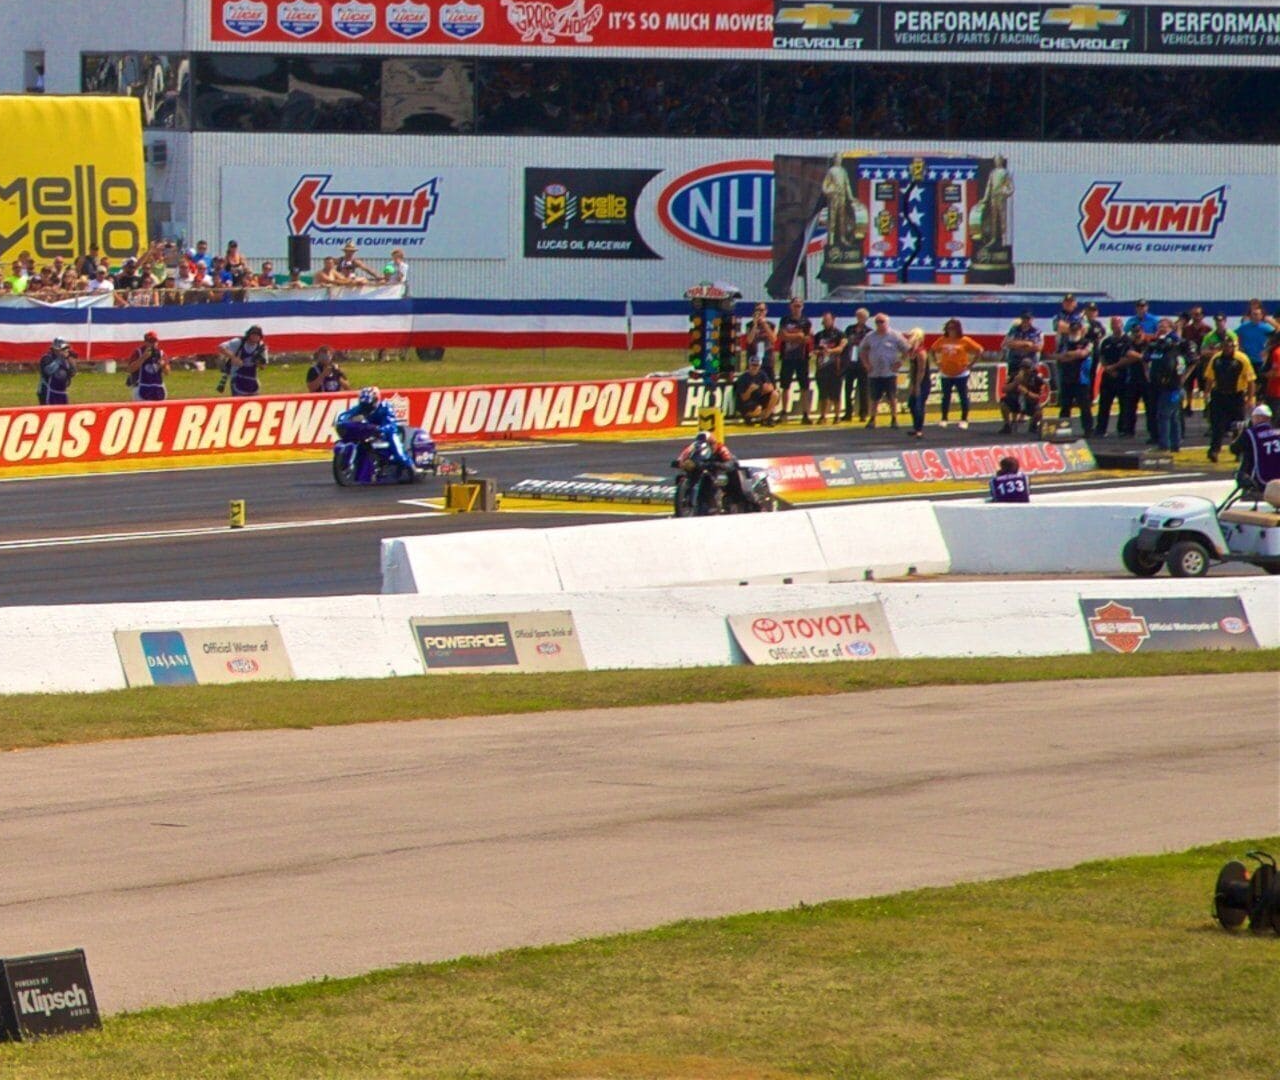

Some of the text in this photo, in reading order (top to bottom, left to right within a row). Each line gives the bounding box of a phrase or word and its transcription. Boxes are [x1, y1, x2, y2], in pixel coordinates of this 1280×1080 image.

[609, 12, 774, 32] IT'S SO MUCH MOWER
[894, 11, 1040, 32] PERFORMANCE
[773, 37, 864, 49] CHEVROLET
[894, 32, 1040, 44] VEHICLES PARTS RACING
[1040, 38, 1131, 50] CHEVROLET
[1161, 34, 1213, 45] VEHICLES
[1223, 34, 1257, 46] PARTS
[356, 237, 425, 247] EQUIPMENT
[537, 240, 632, 250] LUCAS OIL RACEWAY
[1098, 242, 1214, 253] RACING EQUIPMENT
[422, 377, 676, 435] INDIANAPOLIS
[99, 404, 164, 456] OIL
[903, 449, 953, 482] U.S.
[997, 480, 1025, 495] 133
[782, 613, 871, 639] TOYOTA
[203, 640, 268, 654] Official Water of
[424, 633, 507, 650] POWERADE
[810, 646, 830, 659] Car
[147, 652, 189, 670] DASANI
[17, 983, 88, 1017] Klipsch
